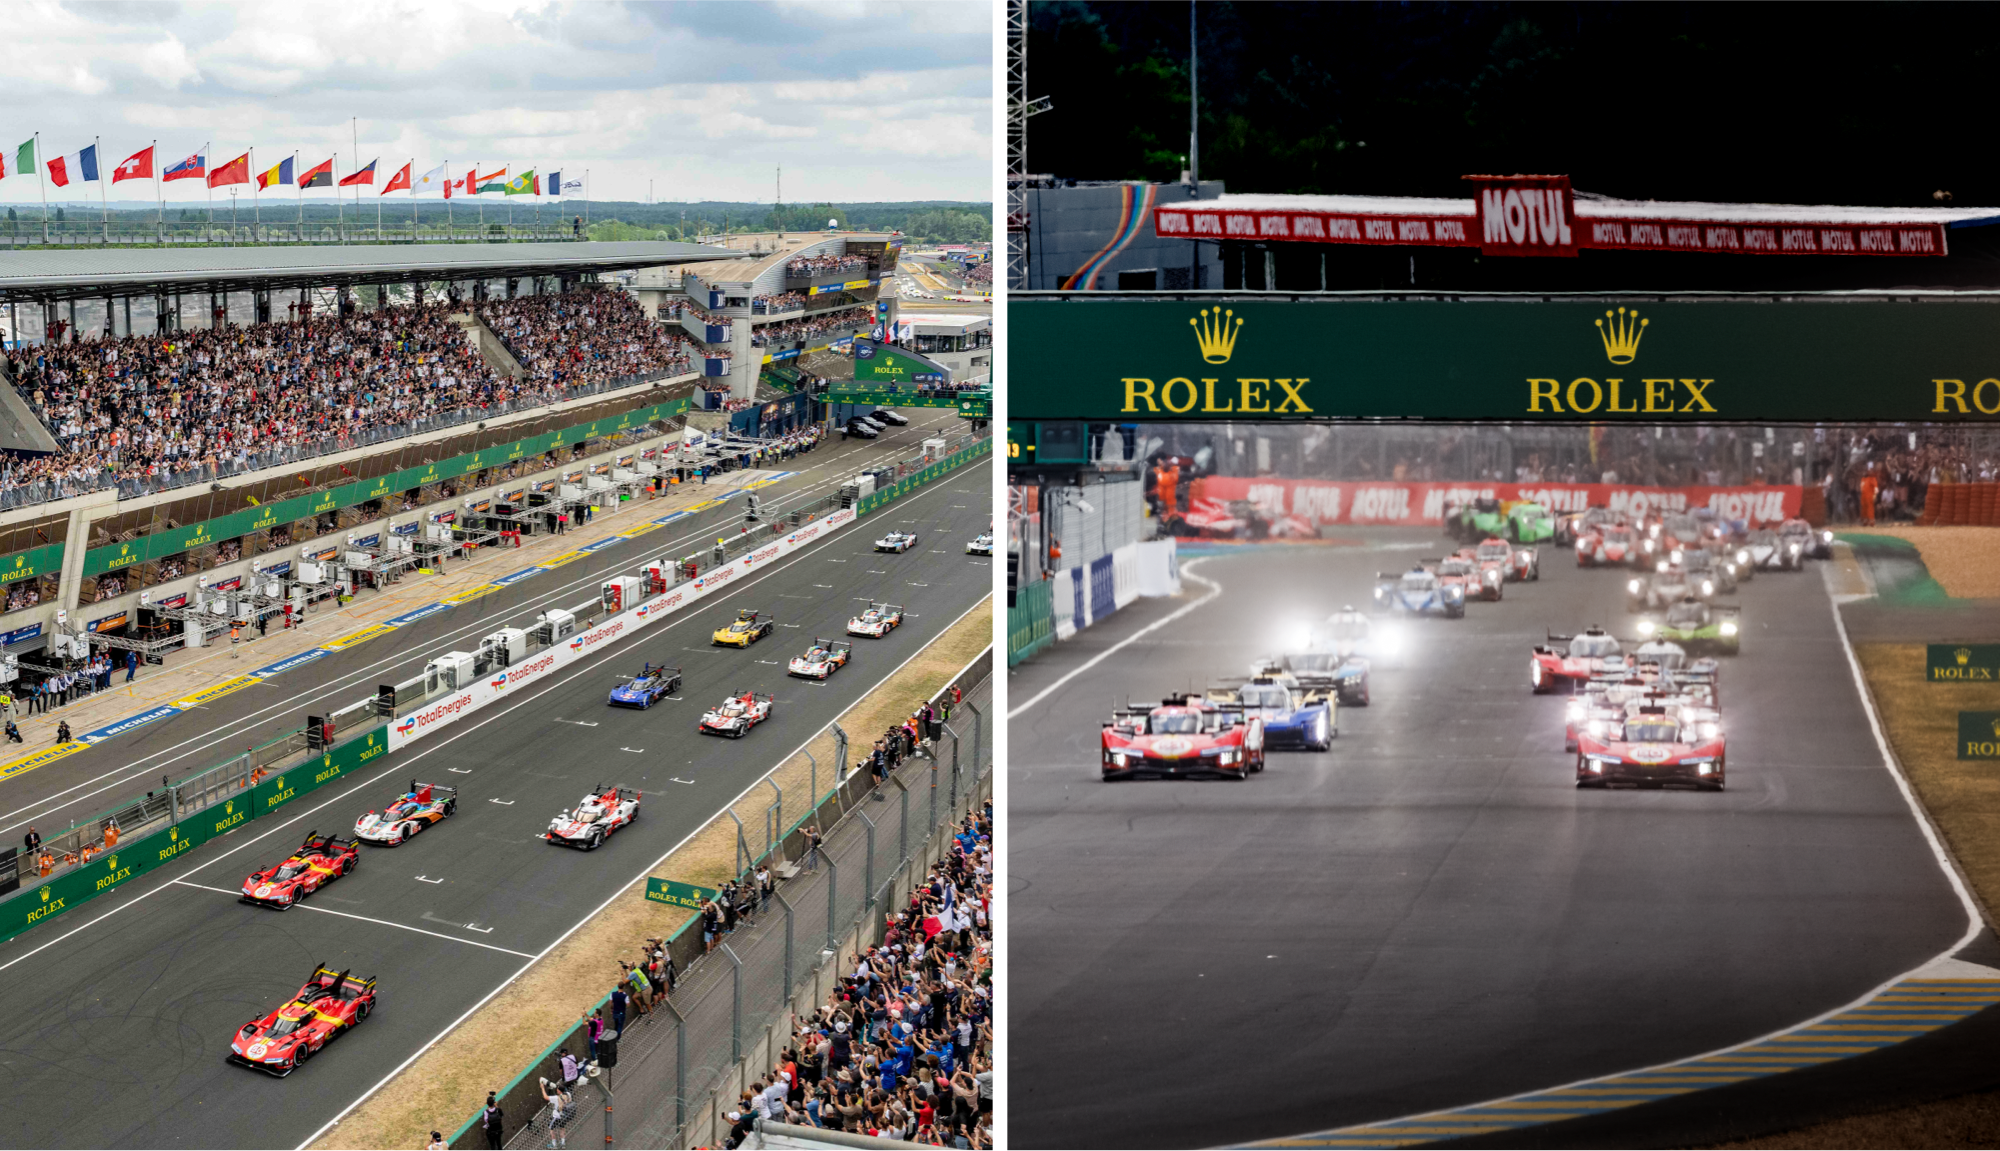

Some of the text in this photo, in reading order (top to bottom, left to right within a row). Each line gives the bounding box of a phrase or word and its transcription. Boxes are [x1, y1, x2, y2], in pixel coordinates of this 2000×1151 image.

[1192, 213, 1222, 235] MOTUL
[1364, 219, 1395, 241] MOTUL
[1398, 220, 1430, 241] MOTUL
[1433, 220, 1466, 242] MOTUL
[1482, 188, 1572, 246] MOTUL
[1593, 223, 1935, 252] MOTUL MOTUL MOTUL MOTUL MOTUL MOTUL MOTUL MOTUL MOTUL
[874, 366, 904, 374] ROLEX
[1120, 377, 1314, 413] ROLEX
[1526, 377, 1717, 413] ROLEX
[466, 462, 483, 472] ROLEX
[420, 474, 439, 484] ROLEX
[370, 487, 389, 498] ROLEX
[1293, 486, 1341, 520] MOTUL
[1351, 488, 1410, 520] MOTUL
[315, 501, 337, 512] ROLEX
[253, 517, 278, 530] ROLEX
[185, 534, 212, 548] ROLEX
[108, 554, 138, 568] ROLEX
[752, 545, 780, 564] TotalEnergies
[1, 567, 34, 582] ROLEX
[703, 567, 734, 588] TotalEnergies
[403, 604, 446, 622] MICHELIN
[648, 591, 682, 614] TotalEnergies
[343, 626, 389, 645] MICHELIN
[583, 620, 624, 648] TotalEnergies
[273, 650, 325, 671] MICHELIN
[507, 654, 554, 684] TotalEnergies
[1933, 666, 1992, 680] ROLEX
[196, 677, 252, 701] MICHELIN
[106, 708, 172, 735] MICHELIN
[417, 694, 472, 729] TotalEnergies
[4, 744, 78, 774] MICHELIN
[360, 744, 383, 762] ROLEX
[316, 765, 340, 784] ROLEX
[268, 787, 296, 808] ROLEX
[215, 811, 244, 832] ROLEX
[159, 838, 190, 860] ROLEX
[96, 866, 131, 890] ROLEX
[648, 890, 678, 904] ROLEX
